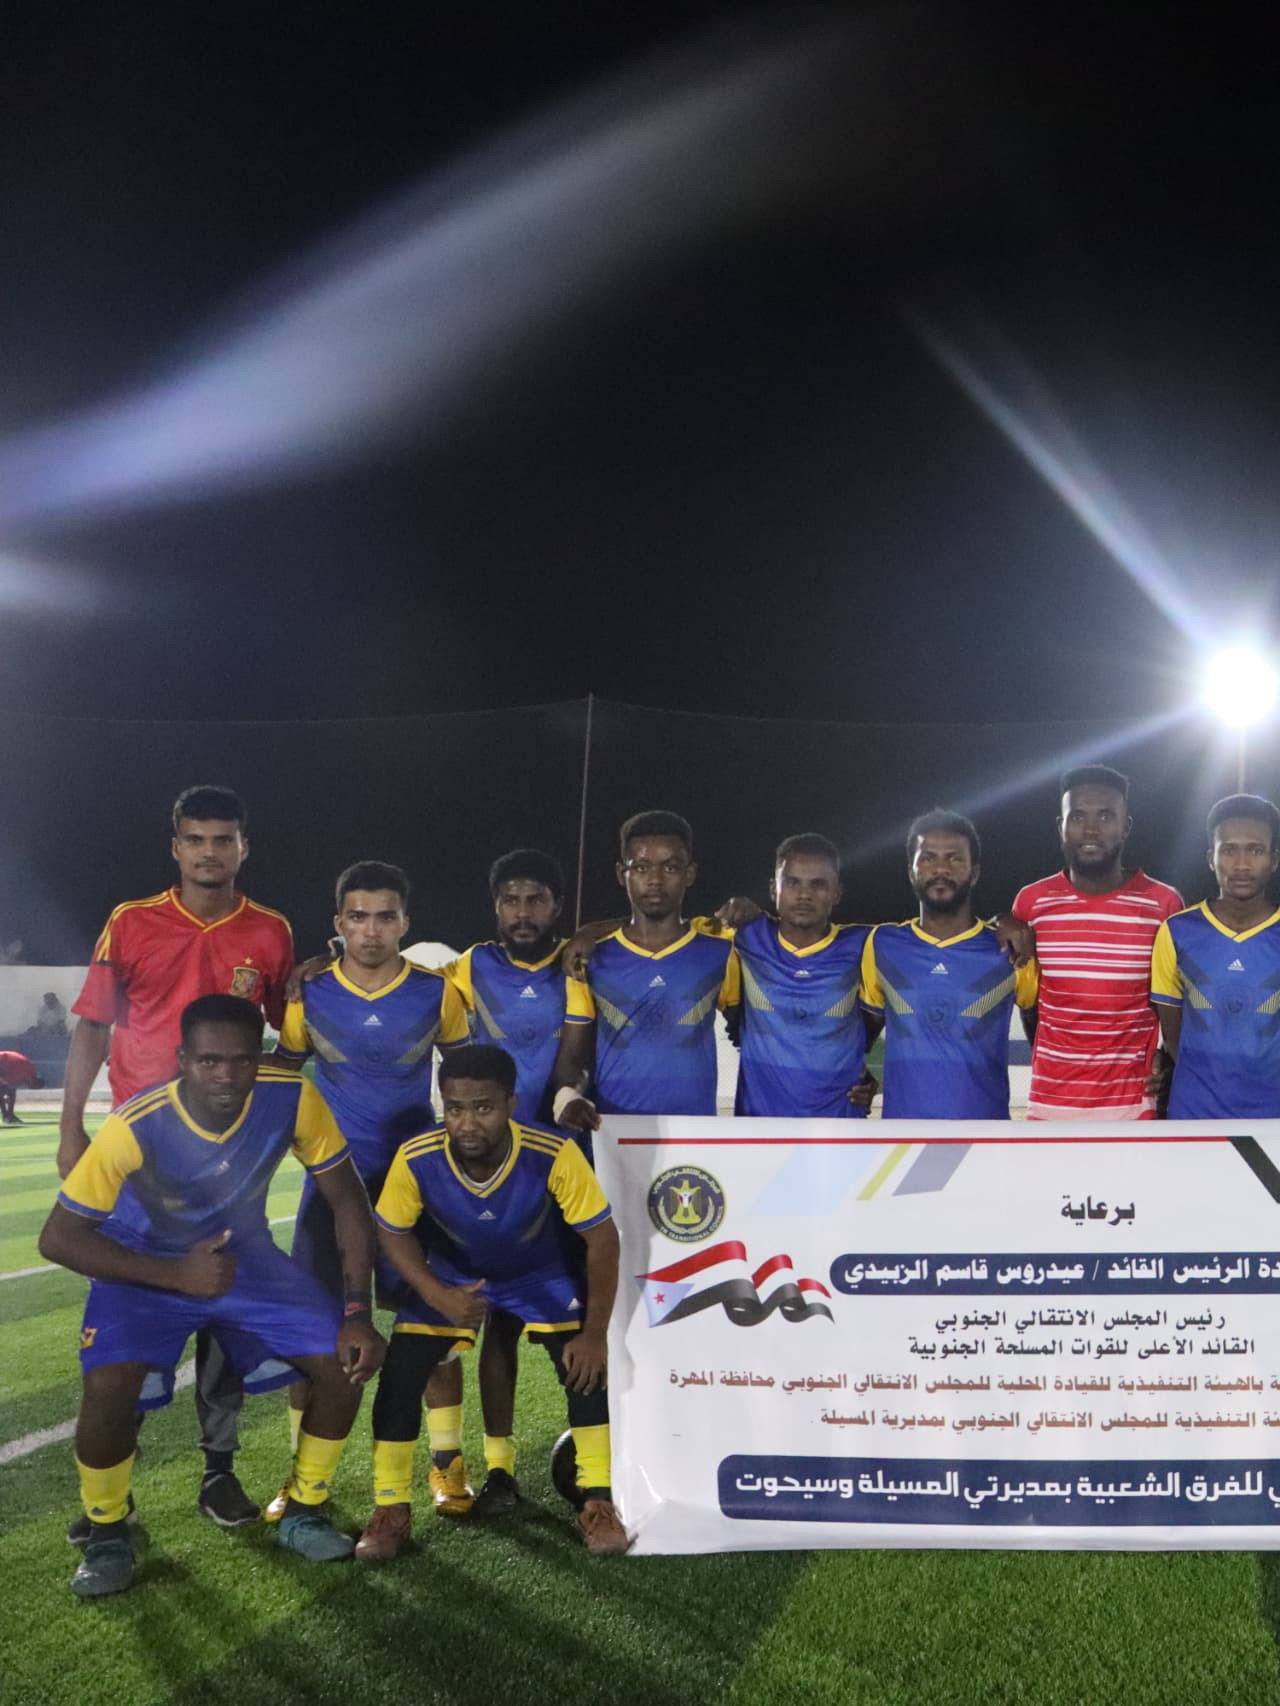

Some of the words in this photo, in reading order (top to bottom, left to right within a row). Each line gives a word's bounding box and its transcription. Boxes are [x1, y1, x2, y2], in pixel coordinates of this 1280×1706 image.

[1060, 1194, 1136, 1227] برعاية
[844, 1258, 929, 1289] الزبيدي
[935, 1258, 989, 1287] قاسم
[995, 1259, 1086, 1285] عيدروس
[1107, 1256, 1164, 1280] القائد
[1172, 1255, 1251, 1284] الرئيس
[935, 1309, 1007, 1335] الجنوبي
[1014, 1308, 1095, 1335] الانتقالي
[1103, 1309, 1168, 1332] المجلس
[1175, 1308, 1226, 1332] رئيس
[907, 1335, 986, 1361] الجنوبية
[994, 1336, 1063, 1356] المسلحة
[1071, 1337, 1129, 1360] للقوات
[1201, 1336, 1255, 1355] القائد
[669, 1368, 715, 1389] المهرة
[719, 1369, 776, 1389] محافظة
[781, 1373, 848, 1396] الجنوبي
[853, 1373, 918, 1397] الانتقالي
[924, 1374, 992, 1395] للمجلس
[996, 1374, 1048, 1395] المحلية
[1053, 1375, 1112, 1396] للقيادة
[1116, 1375, 1199, 1396] التنفيذية
[820, 1407, 876, 1429] المسيلة
[881, 1409, 946, 1431] بمديرية
[951, 1411, 1021, 1436] الجنوبي
[1026, 1411, 1093, 1436] الانتقالي
[1099, 1411, 1169, 1433] للمجلس
[1173, 1411, 1257, 1433] التنفيذية
[735, 1473, 854, 1500] وسيحوت
[857, 1469, 960, 1502] المسيلة
[1076, 1471, 1181, 1505] الشعبية
[1184, 1470, 1263, 1503] للفرق
